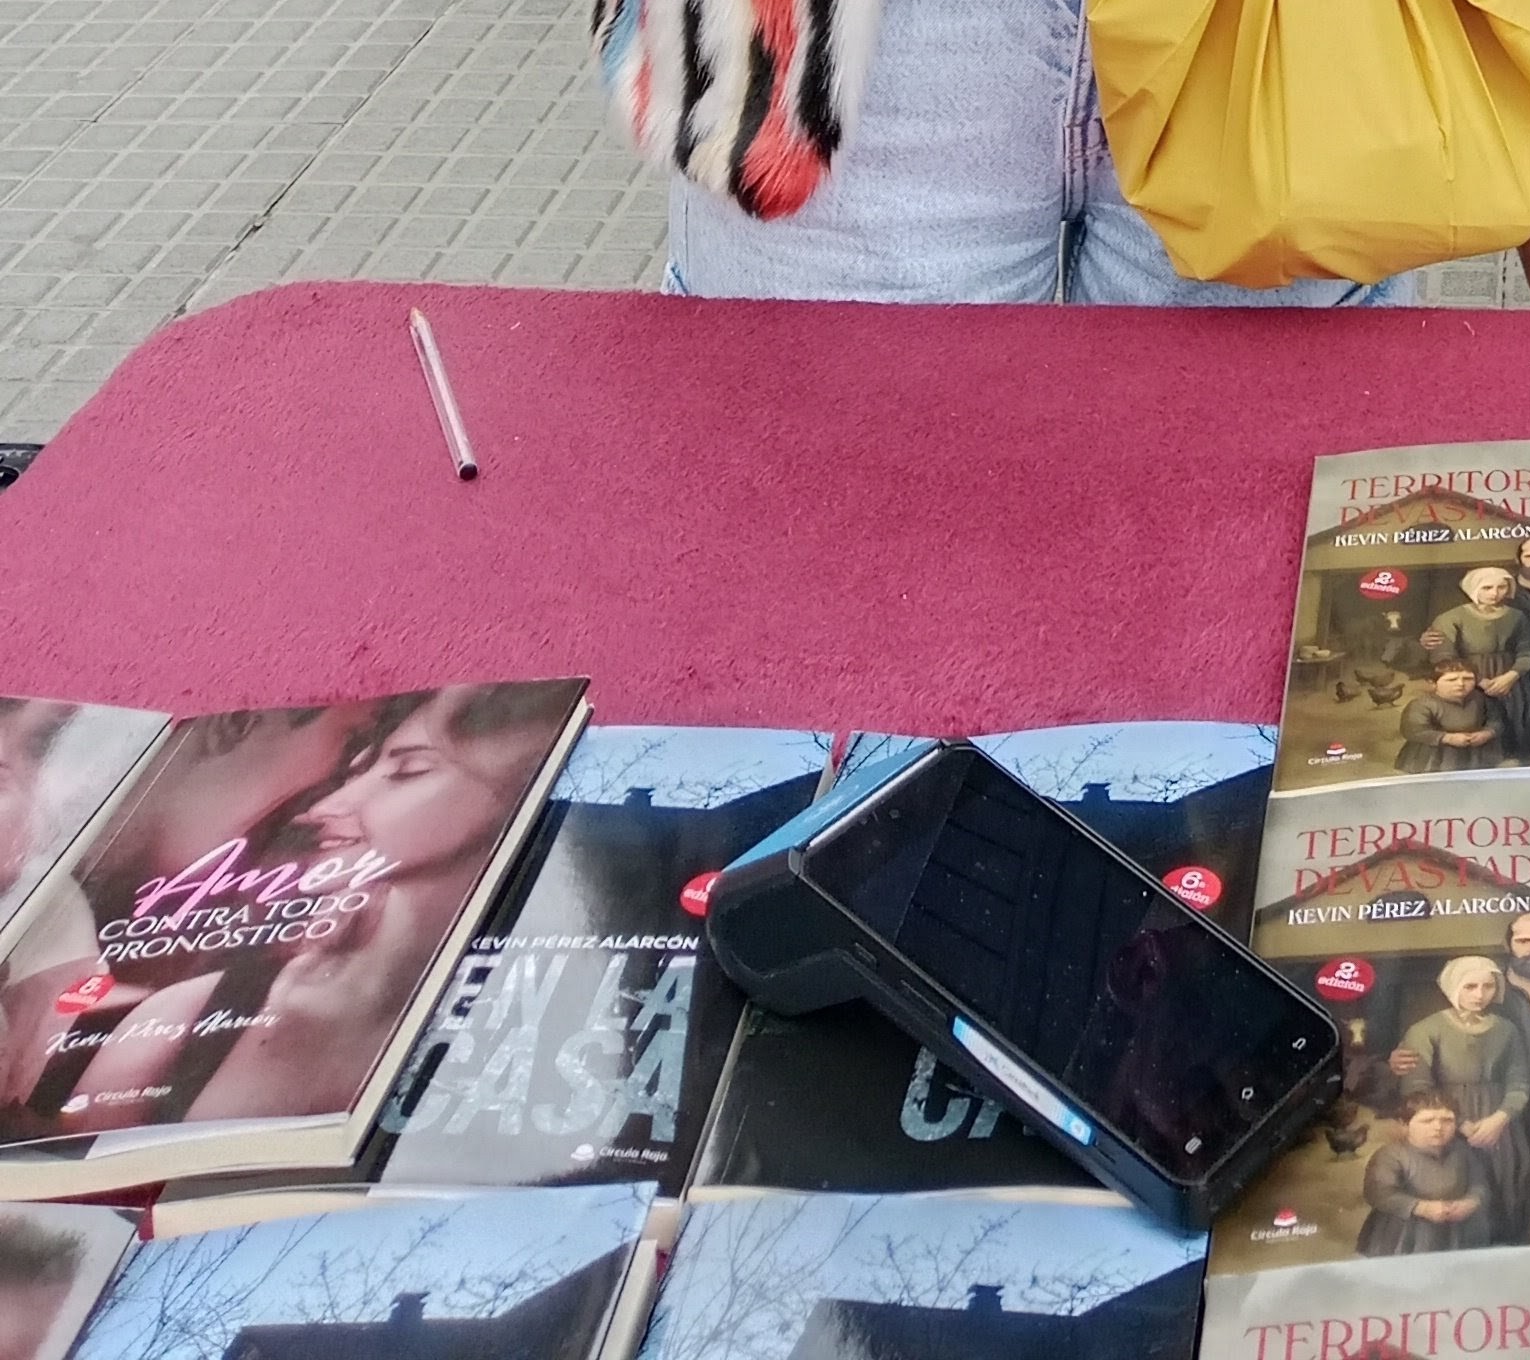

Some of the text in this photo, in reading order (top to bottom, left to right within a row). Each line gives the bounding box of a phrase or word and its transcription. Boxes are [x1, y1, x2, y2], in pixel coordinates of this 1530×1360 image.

[1335, 532, 1388, 547] KEVIN
[1394, 528, 1451, 543] PÉREZ
[134, 838, 402, 930] Amor
[98, 893, 370, 942] CONTRA TODO
[1288, 893, 1530, 925] KEVIN PÉREZ ALARCÓN
[97, 918, 337, 963] PRONÓSTICO
[599, 934, 699, 951] ALARCÓN
